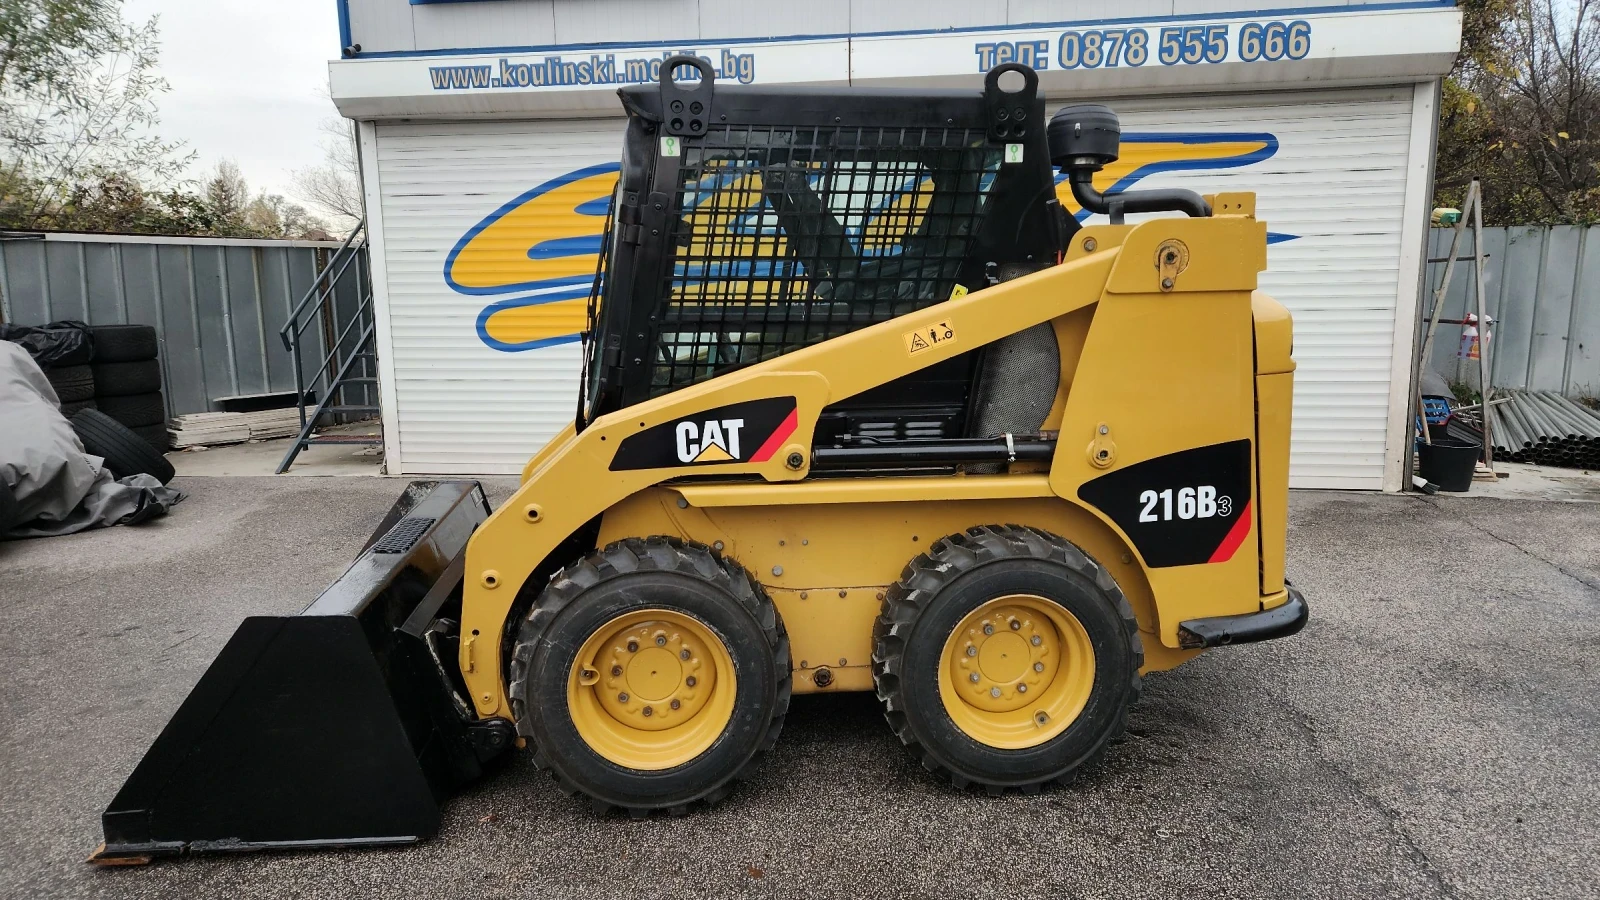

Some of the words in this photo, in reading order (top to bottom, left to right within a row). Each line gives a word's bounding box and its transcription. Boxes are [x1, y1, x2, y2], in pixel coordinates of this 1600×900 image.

[975, 40, 1049, 72] тел:
[1058, 28, 1149, 70] 0878
[1158, 25, 1229, 66] 555
[1238, 20, 1311, 62] 666
[676, 419, 744, 463] CAT
